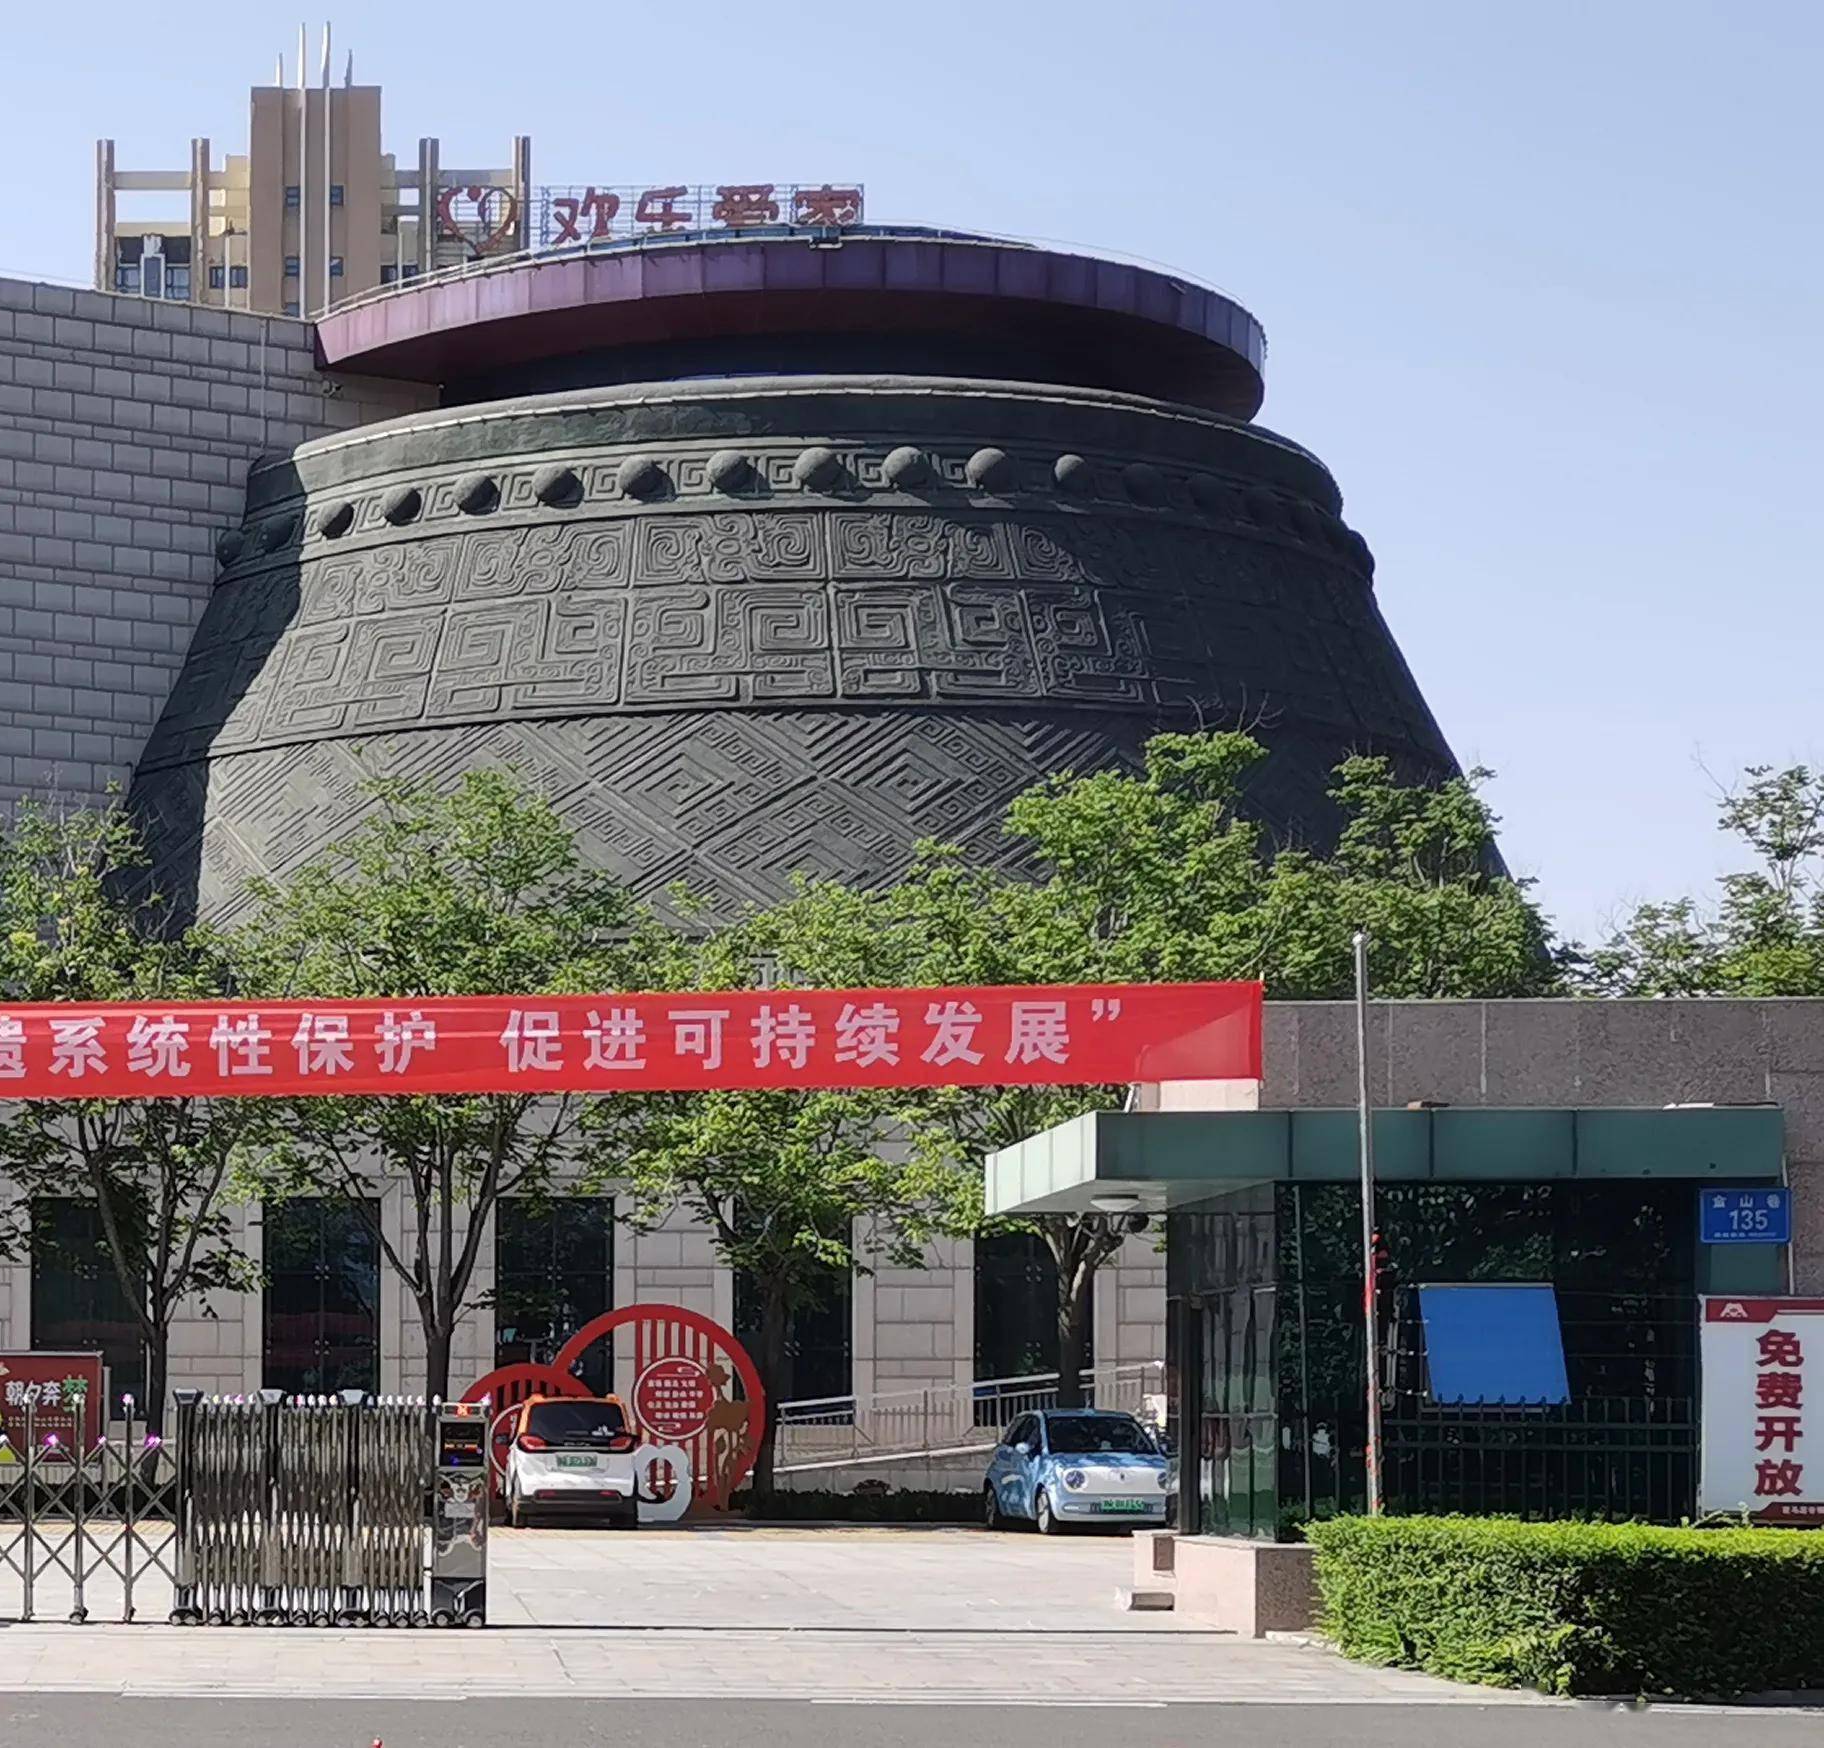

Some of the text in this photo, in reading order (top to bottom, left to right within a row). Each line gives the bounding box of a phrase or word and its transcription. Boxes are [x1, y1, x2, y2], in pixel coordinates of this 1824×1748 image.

[552, 184, 861, 244] 欢乐爱家
[498, 998, 1121, 1073] 促进可持续发展”
[1729, 1210, 1768, 1230] 135
[1754, 1329, 1804, 1497] 免费开放
